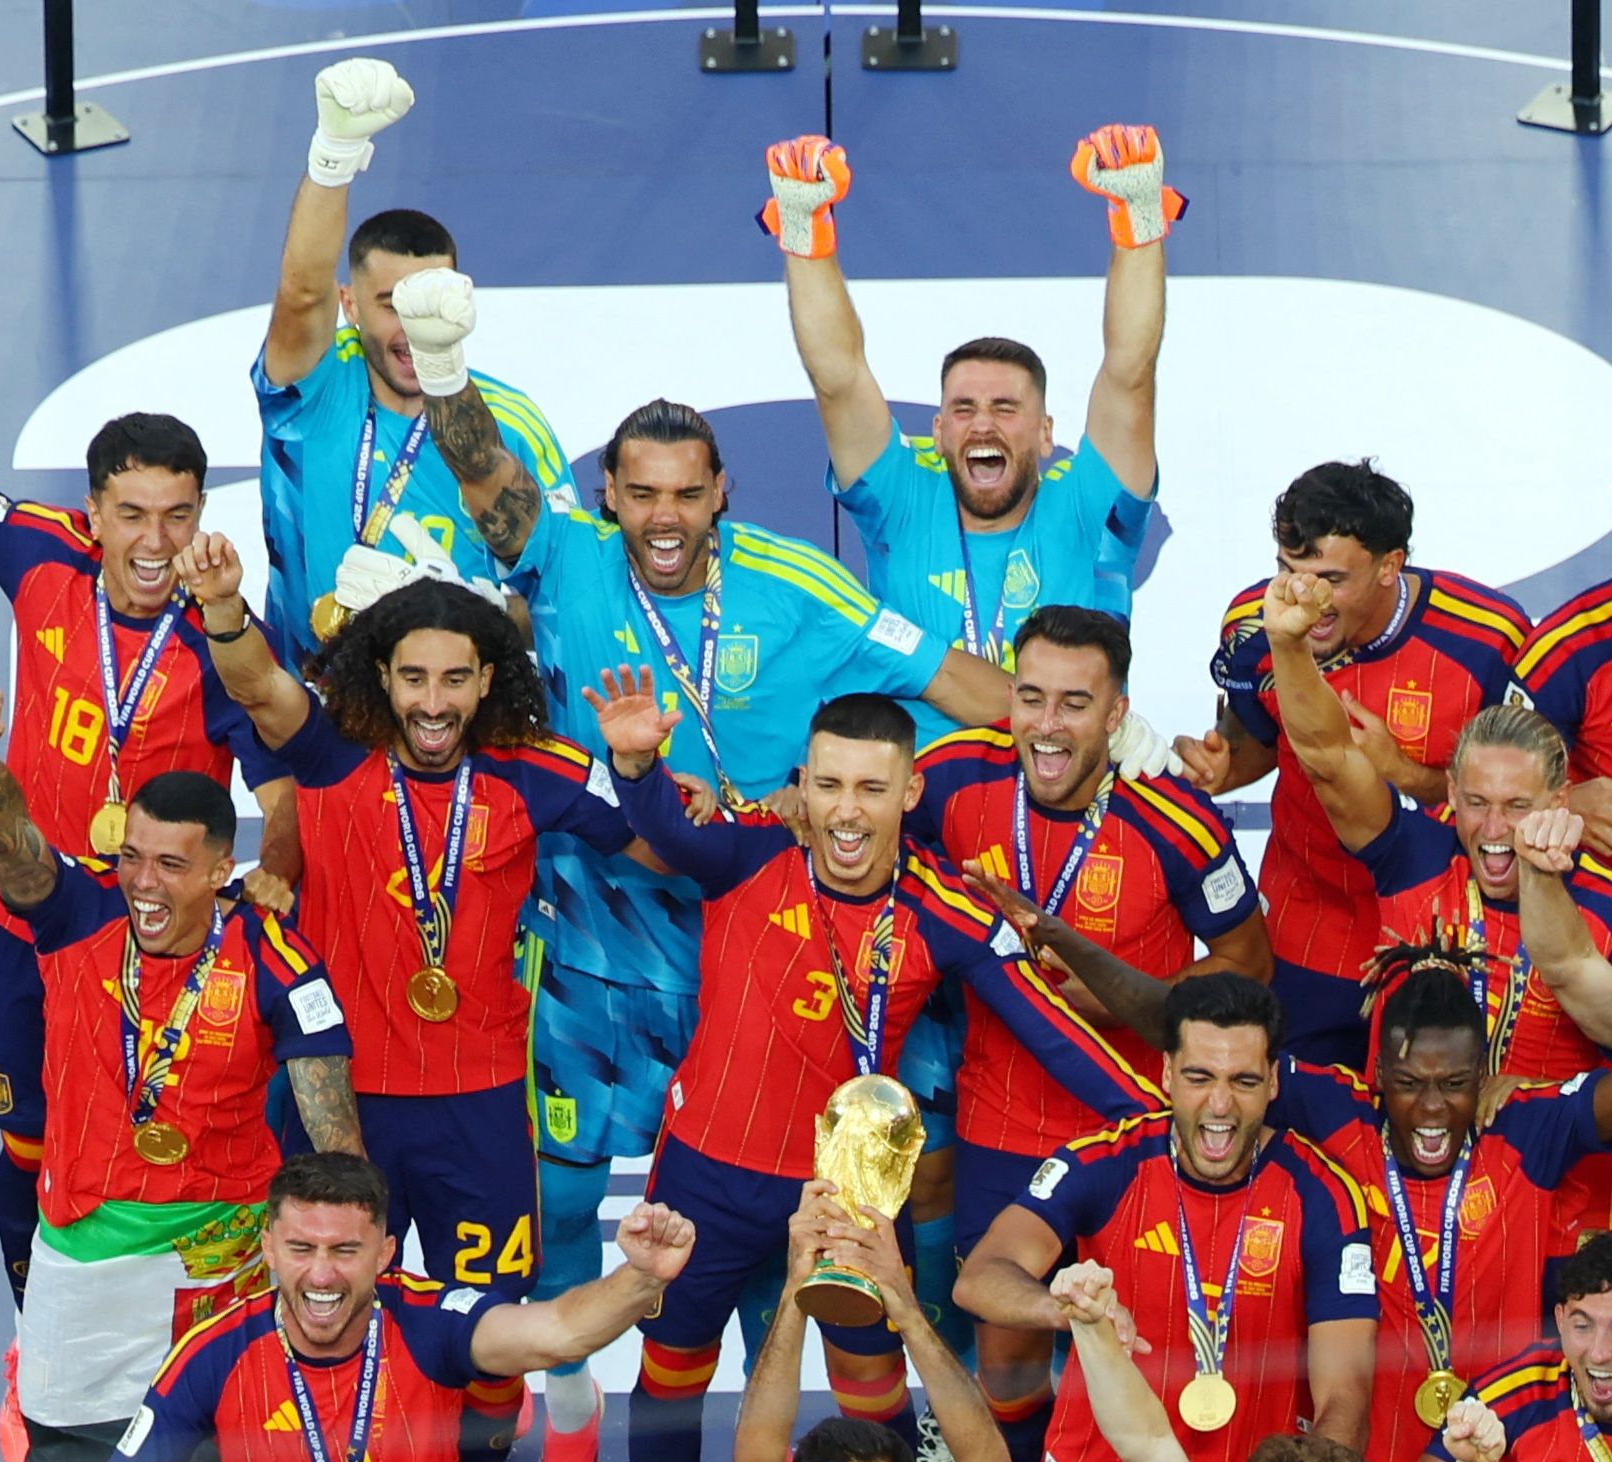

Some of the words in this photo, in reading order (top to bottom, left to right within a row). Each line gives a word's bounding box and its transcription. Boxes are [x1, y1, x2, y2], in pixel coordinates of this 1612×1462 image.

[363, 419, 373, 443] FIFA
[406, 428, 422, 454] FIFA
[357, 441, 371, 483] WORLD
[355, 480, 365, 504] CUP
[98, 601, 107, 627] FIFA
[637, 590, 653, 613] CUP
[647, 609, 671, 647] 2026
[1368, 635, 1389, 650] FIFA
[1385, 599, 1405, 635] WORLD
[965, 618, 976, 642] CUP
[100, 625, 112, 667] WORLD
[702, 639, 714, 679] 2026
[103, 665, 115, 689] CUP
[118, 704, 132, 727] FIFA
[126, 668, 147, 705] WORLD
[141, 647, 155, 669] CUP
[150, 614, 174, 650] 2026
[699, 678, 710, 702] CUP
[48, 685, 105, 766] 18
[394, 782, 406, 807] FIFA
[457, 766, 470, 805] 2026
[399, 805, 414, 843] WORLD
[453, 801, 466, 826] CUP
[1016, 789, 1025, 831] WORLD
[406, 843, 418, 864] CUP
[447, 826, 461, 864] WORLD
[1017, 829, 1027, 852] CUP
[411, 864, 425, 900] 2026
[444, 865, 456, 887] FIFA
[1019, 853, 1031, 890] 2026
[1052, 879, 1068, 899] CUP
[1061, 845, 1083, 881] 2026
[792, 970, 839, 1022] 3
[1473, 980, 1483, 1003] FIFA
[869, 994, 881, 1031] 2026
[125, 1034, 135, 1059] FIFA
[868, 1030, 877, 1052] CUP
[1388, 1170, 1401, 1195] FIFA
[1447, 1169, 1463, 1208] 2026
[1394, 1193, 1411, 1233] WORLD
[1444, 1206, 1456, 1230] CUP
[454, 1213, 534, 1284] 24
[1183, 1242, 1192, 1264] CUP
[1403, 1233, 1416, 1255] CUP
[1442, 1230, 1453, 1269] WORLD
[1186, 1263, 1199, 1301] 2026
[1224, 1268, 1235, 1294] FIFA
[1408, 1255, 1425, 1292] 2026
[1440, 1267, 1450, 1293] FIFA
[367, 1318, 378, 1358] 2026
[292, 1371, 305, 1394] FIFA
[363, 1358, 374, 1380] CUP
[298, 1393, 315, 1430] WORLD
[357, 1380, 371, 1418] WORLD
[308, 1430, 321, 1451] CUP
[353, 1418, 365, 1441] FIFA
